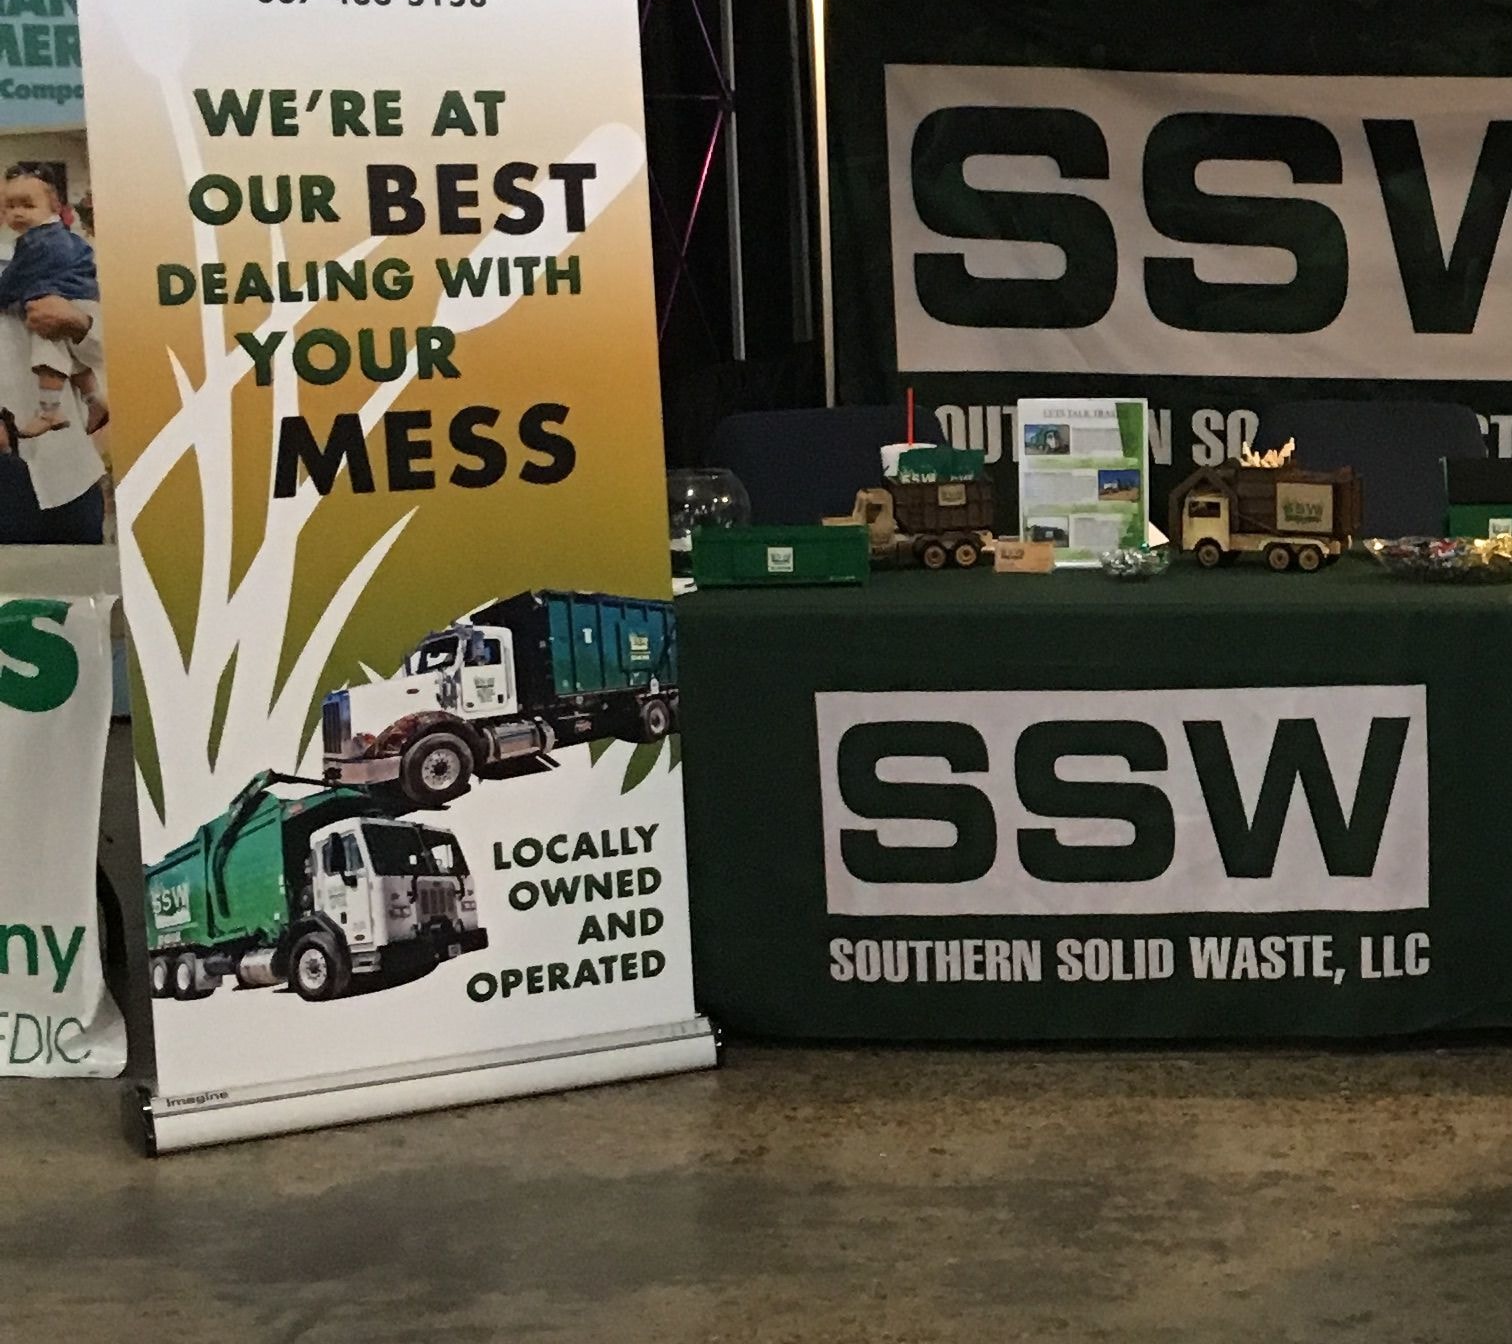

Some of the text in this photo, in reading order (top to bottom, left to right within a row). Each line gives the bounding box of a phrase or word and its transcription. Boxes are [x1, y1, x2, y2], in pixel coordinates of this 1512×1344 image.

[194, 89, 507, 137] WE'RE AT
[188, 162, 597, 237] OUR BEST
[156, 255, 582, 307] DEALING WITH
[234, 324, 462, 388] YOUR
[274, 403, 578, 499] MESS
[837, 716, 1411, 884] SSW
[492, 822, 660, 871] LOCALLY
[508, 866, 663, 911] OWNED
[578, 907, 664, 946] AND
[466, 949, 667, 1004] OPERATED
[829, 932, 1430, 985] SOUTHERN SOLID WASTE, LLC
